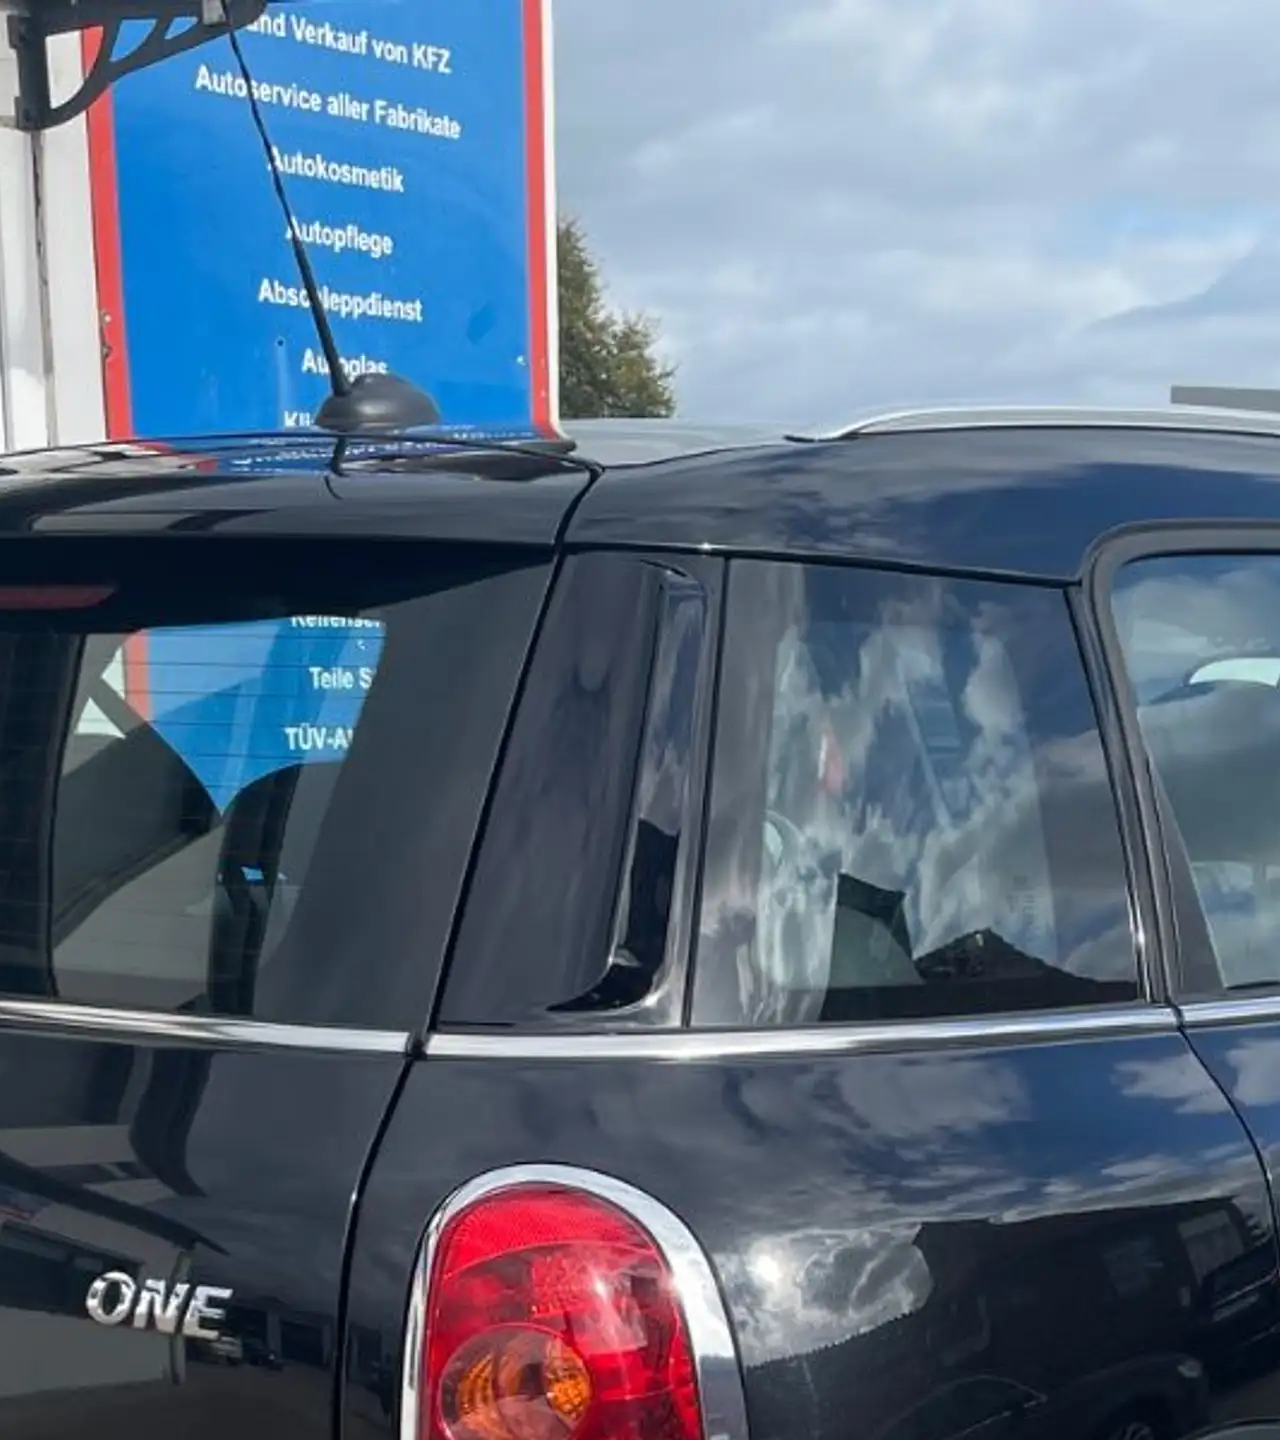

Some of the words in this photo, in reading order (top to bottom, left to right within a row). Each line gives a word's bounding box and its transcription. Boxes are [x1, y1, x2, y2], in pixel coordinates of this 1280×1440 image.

[291, 15, 368, 56] Verkauf
[371, 38, 409, 64] von
[411, 42, 453, 75] KFZ
[195, 64, 322, 112] Autoservice
[325, 91, 370, 122] aller
[373, 99, 463, 140] Fabrikate
[267, 144, 405, 193] Autokosmetik
[284, 215, 394, 259] Autopflege
[257, 277, 423, 323] Abscleppdienst
[308, 666, 355, 691] Teile
[359, 666, 377, 690] S
[284, 722, 354, 751] TÜV-A
[86, 1270, 234, 1340] ONE
